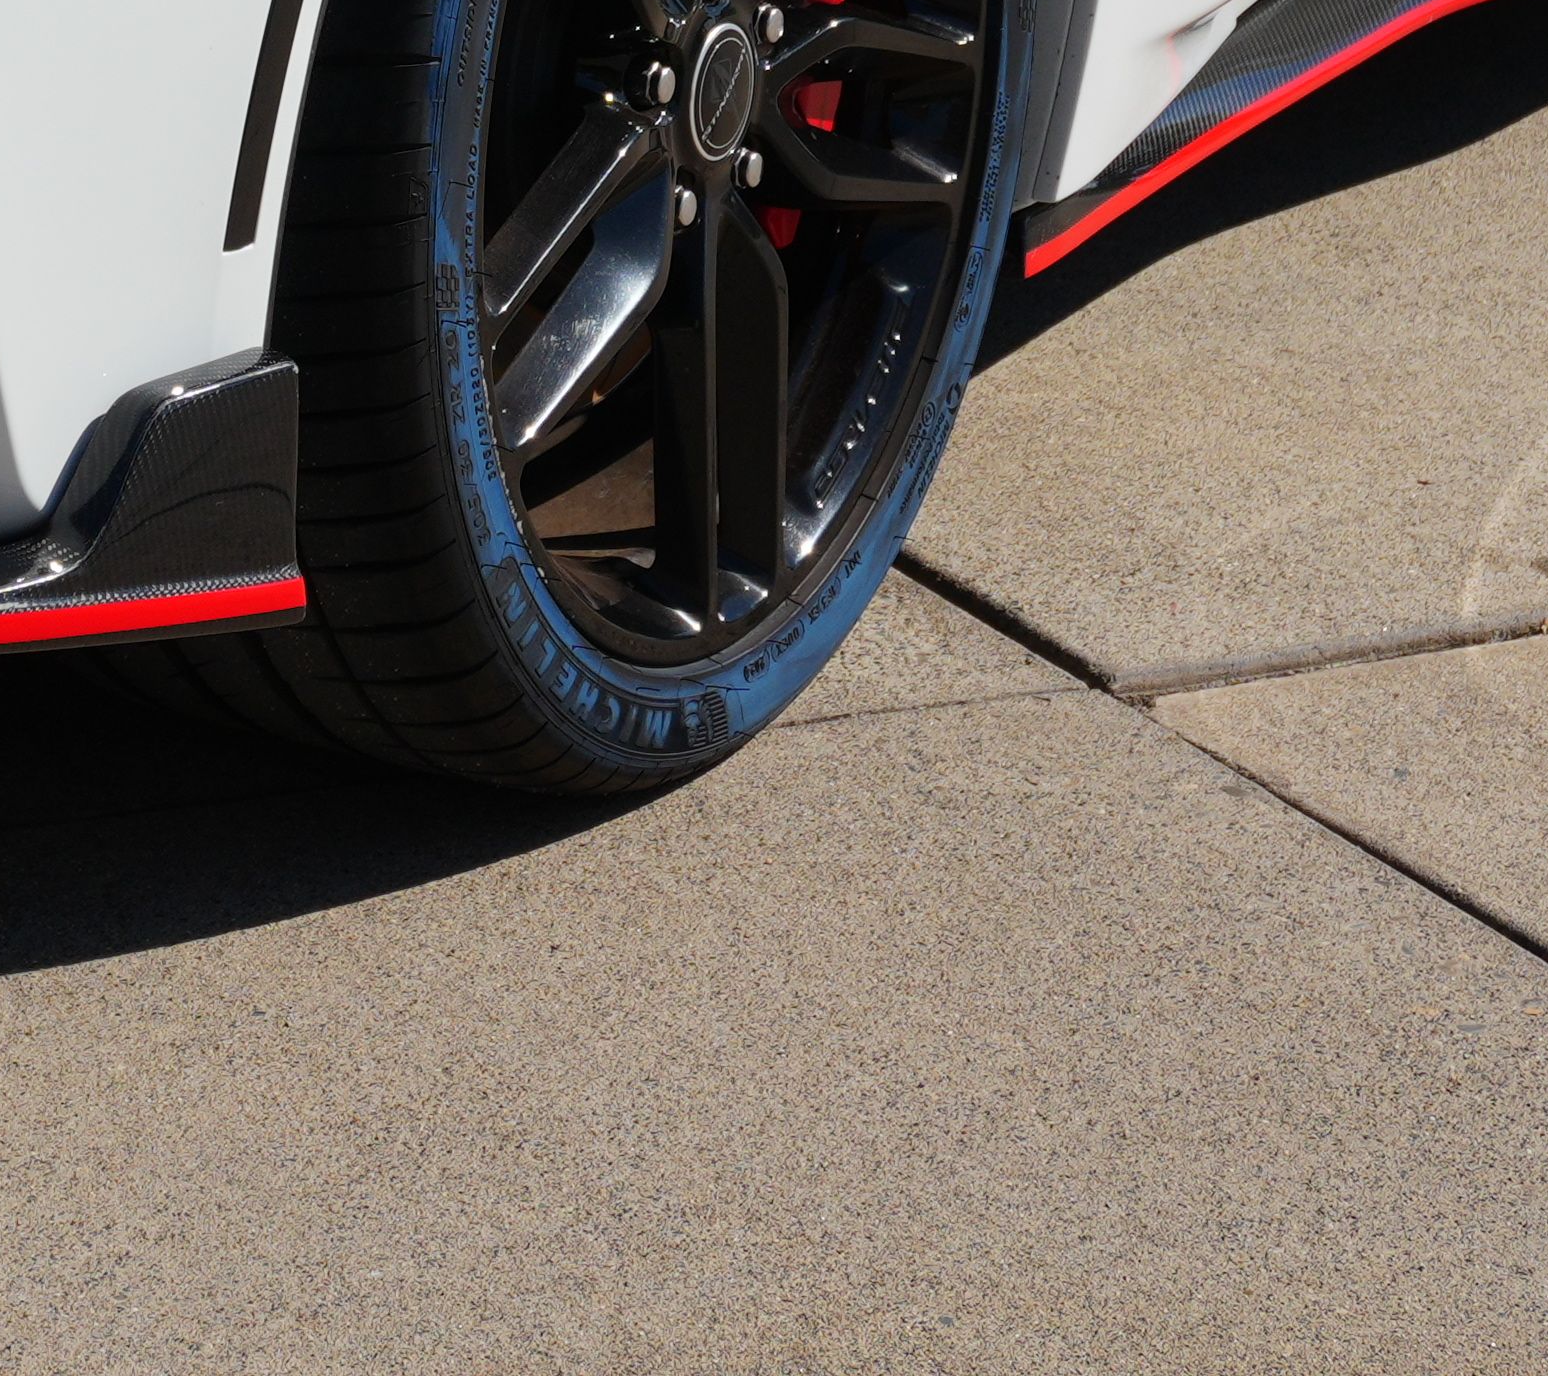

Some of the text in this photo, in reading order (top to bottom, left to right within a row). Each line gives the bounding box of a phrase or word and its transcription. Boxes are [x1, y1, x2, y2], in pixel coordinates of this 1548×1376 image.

[470, 84, 486, 128] MADE
[478, 58, 487, 76] IN
[467, 142, 477, 200] LOAD
[464, 210, 475, 279] EXTRA
[444, 329, 492, 548] 305/30 ZR 20
[843, 549, 862, 579] DOT
[496, 580, 673, 749] MICHELIN
